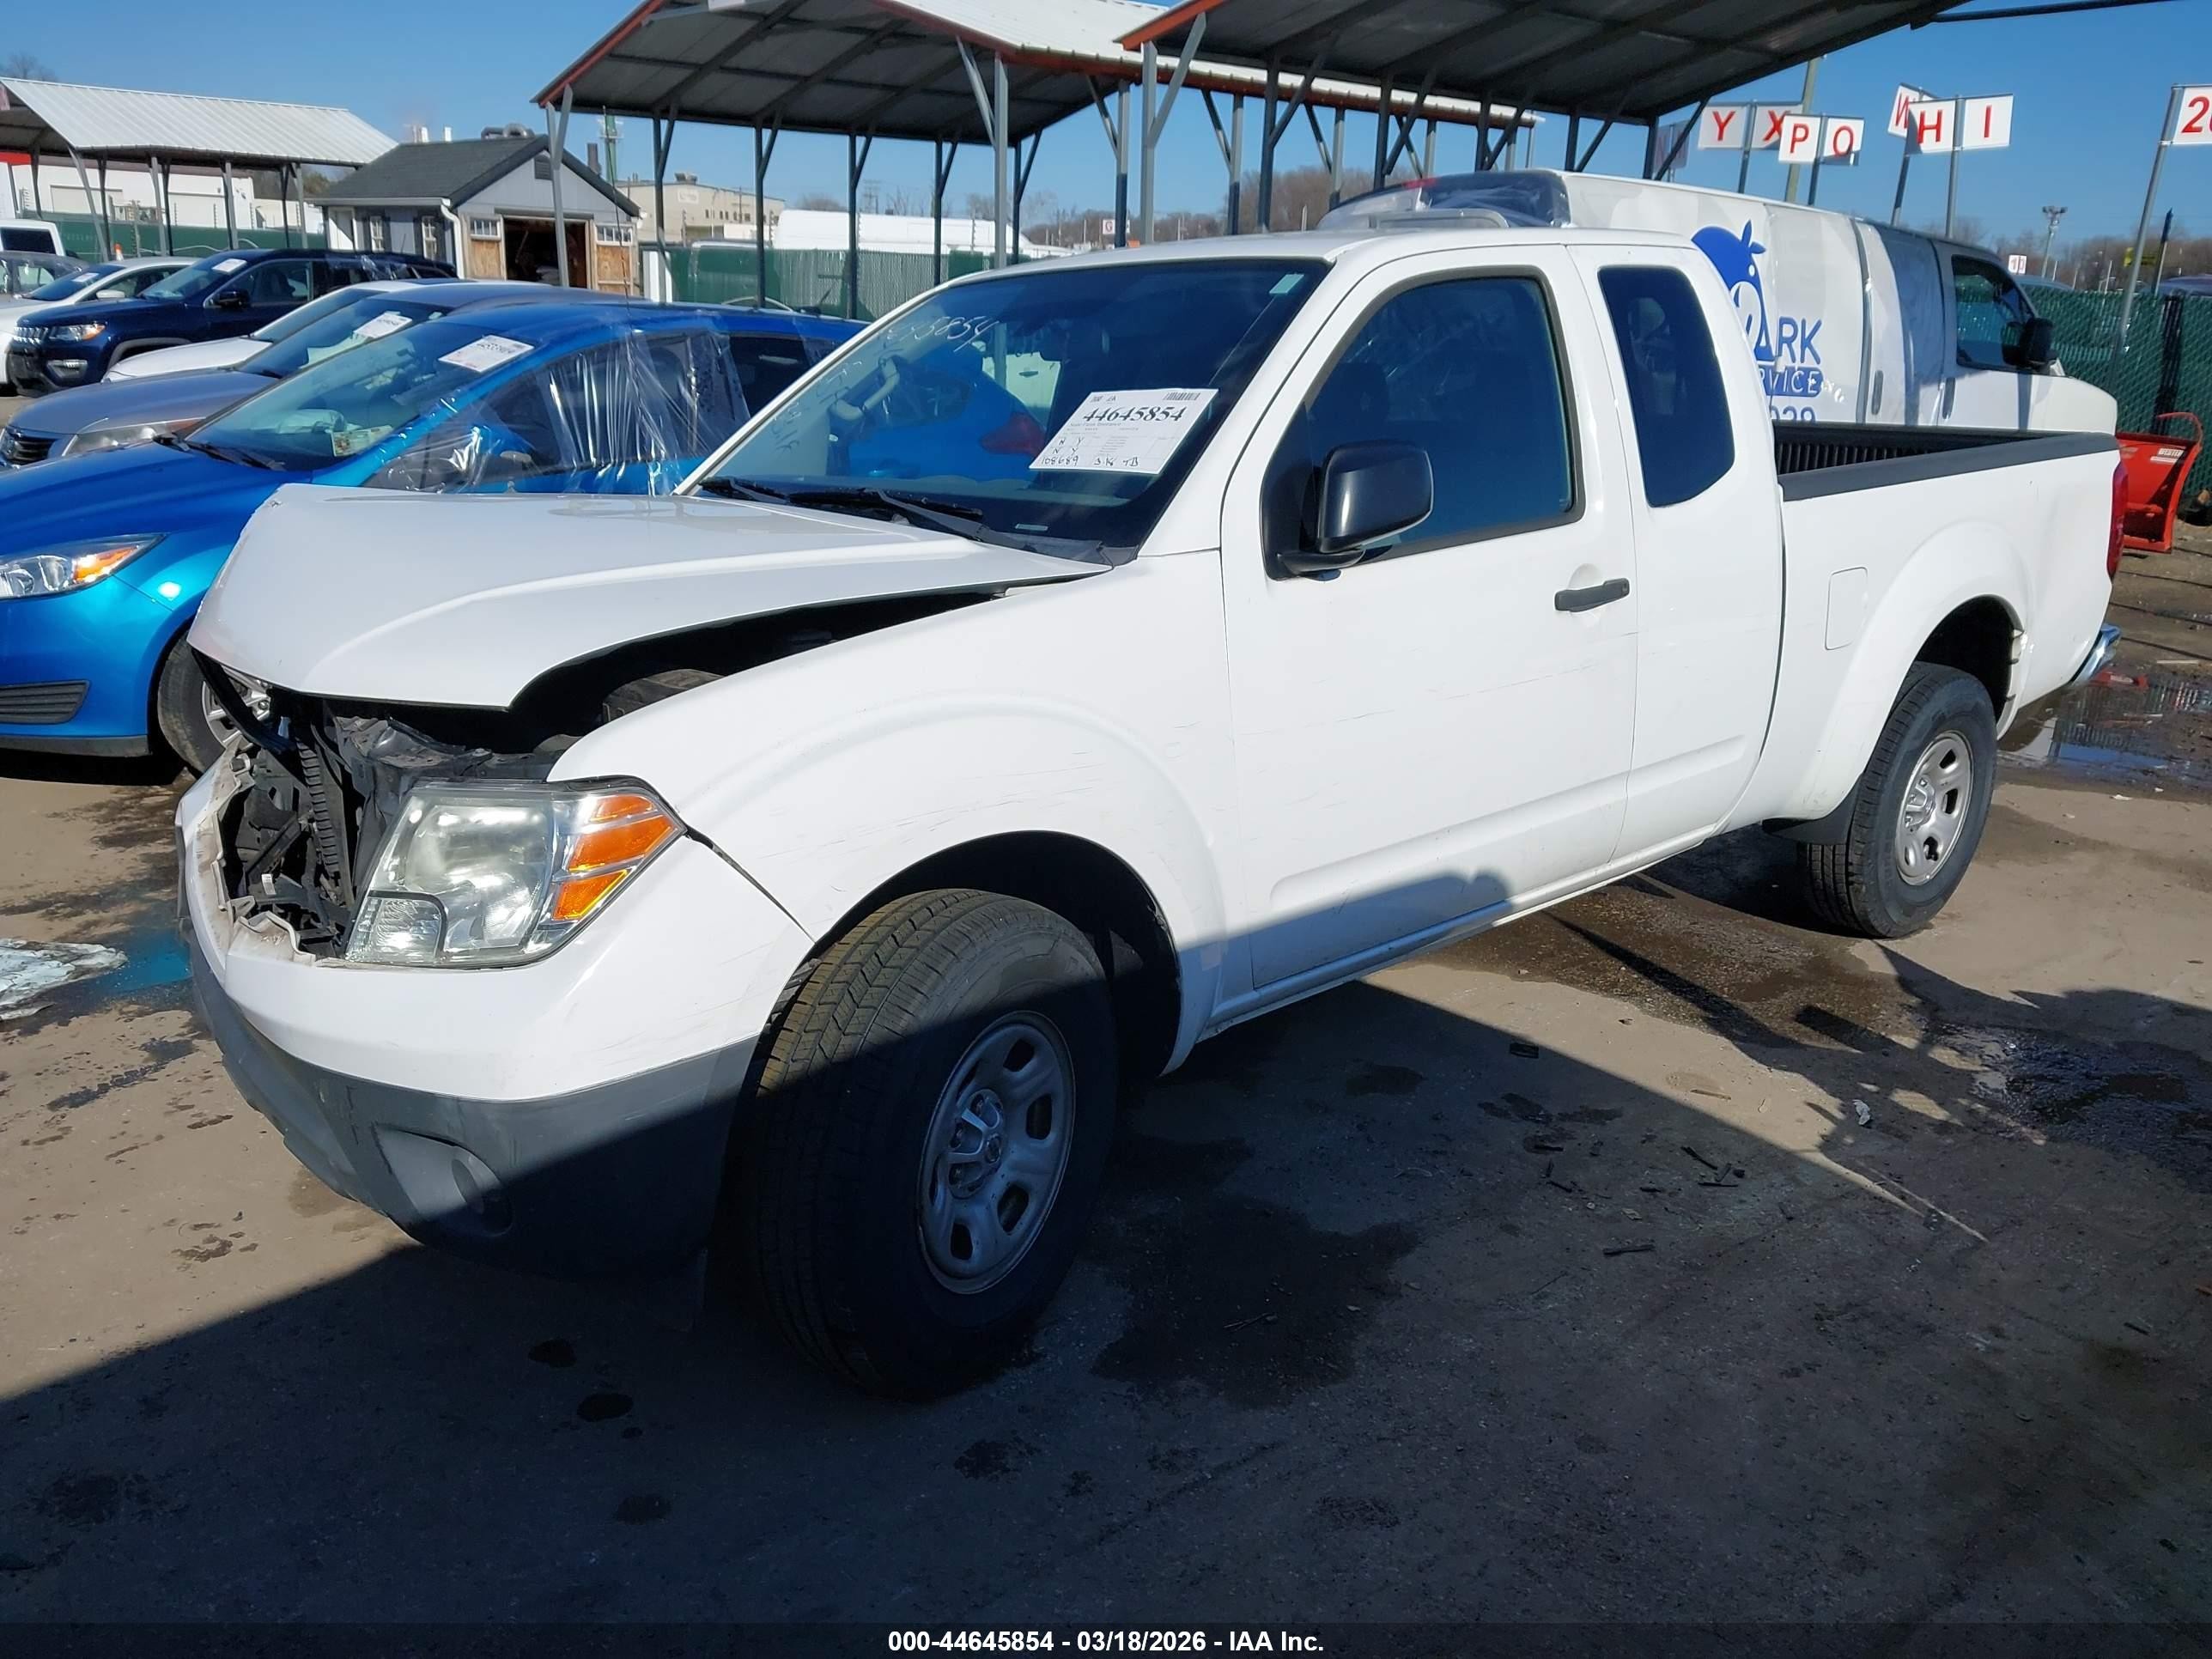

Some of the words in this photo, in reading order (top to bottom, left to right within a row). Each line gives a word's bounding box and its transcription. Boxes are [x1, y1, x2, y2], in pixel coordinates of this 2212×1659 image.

[1712, 110, 1736, 141] Y
[1763, 109, 1791, 142] X
[1917, 108, 1942, 144] H
[1984, 104, 1992, 138] I
[2181, 95, 2212, 133] 2
[1790, 123, 1809, 154] P
[1083, 406, 1187, 422] 44645854
